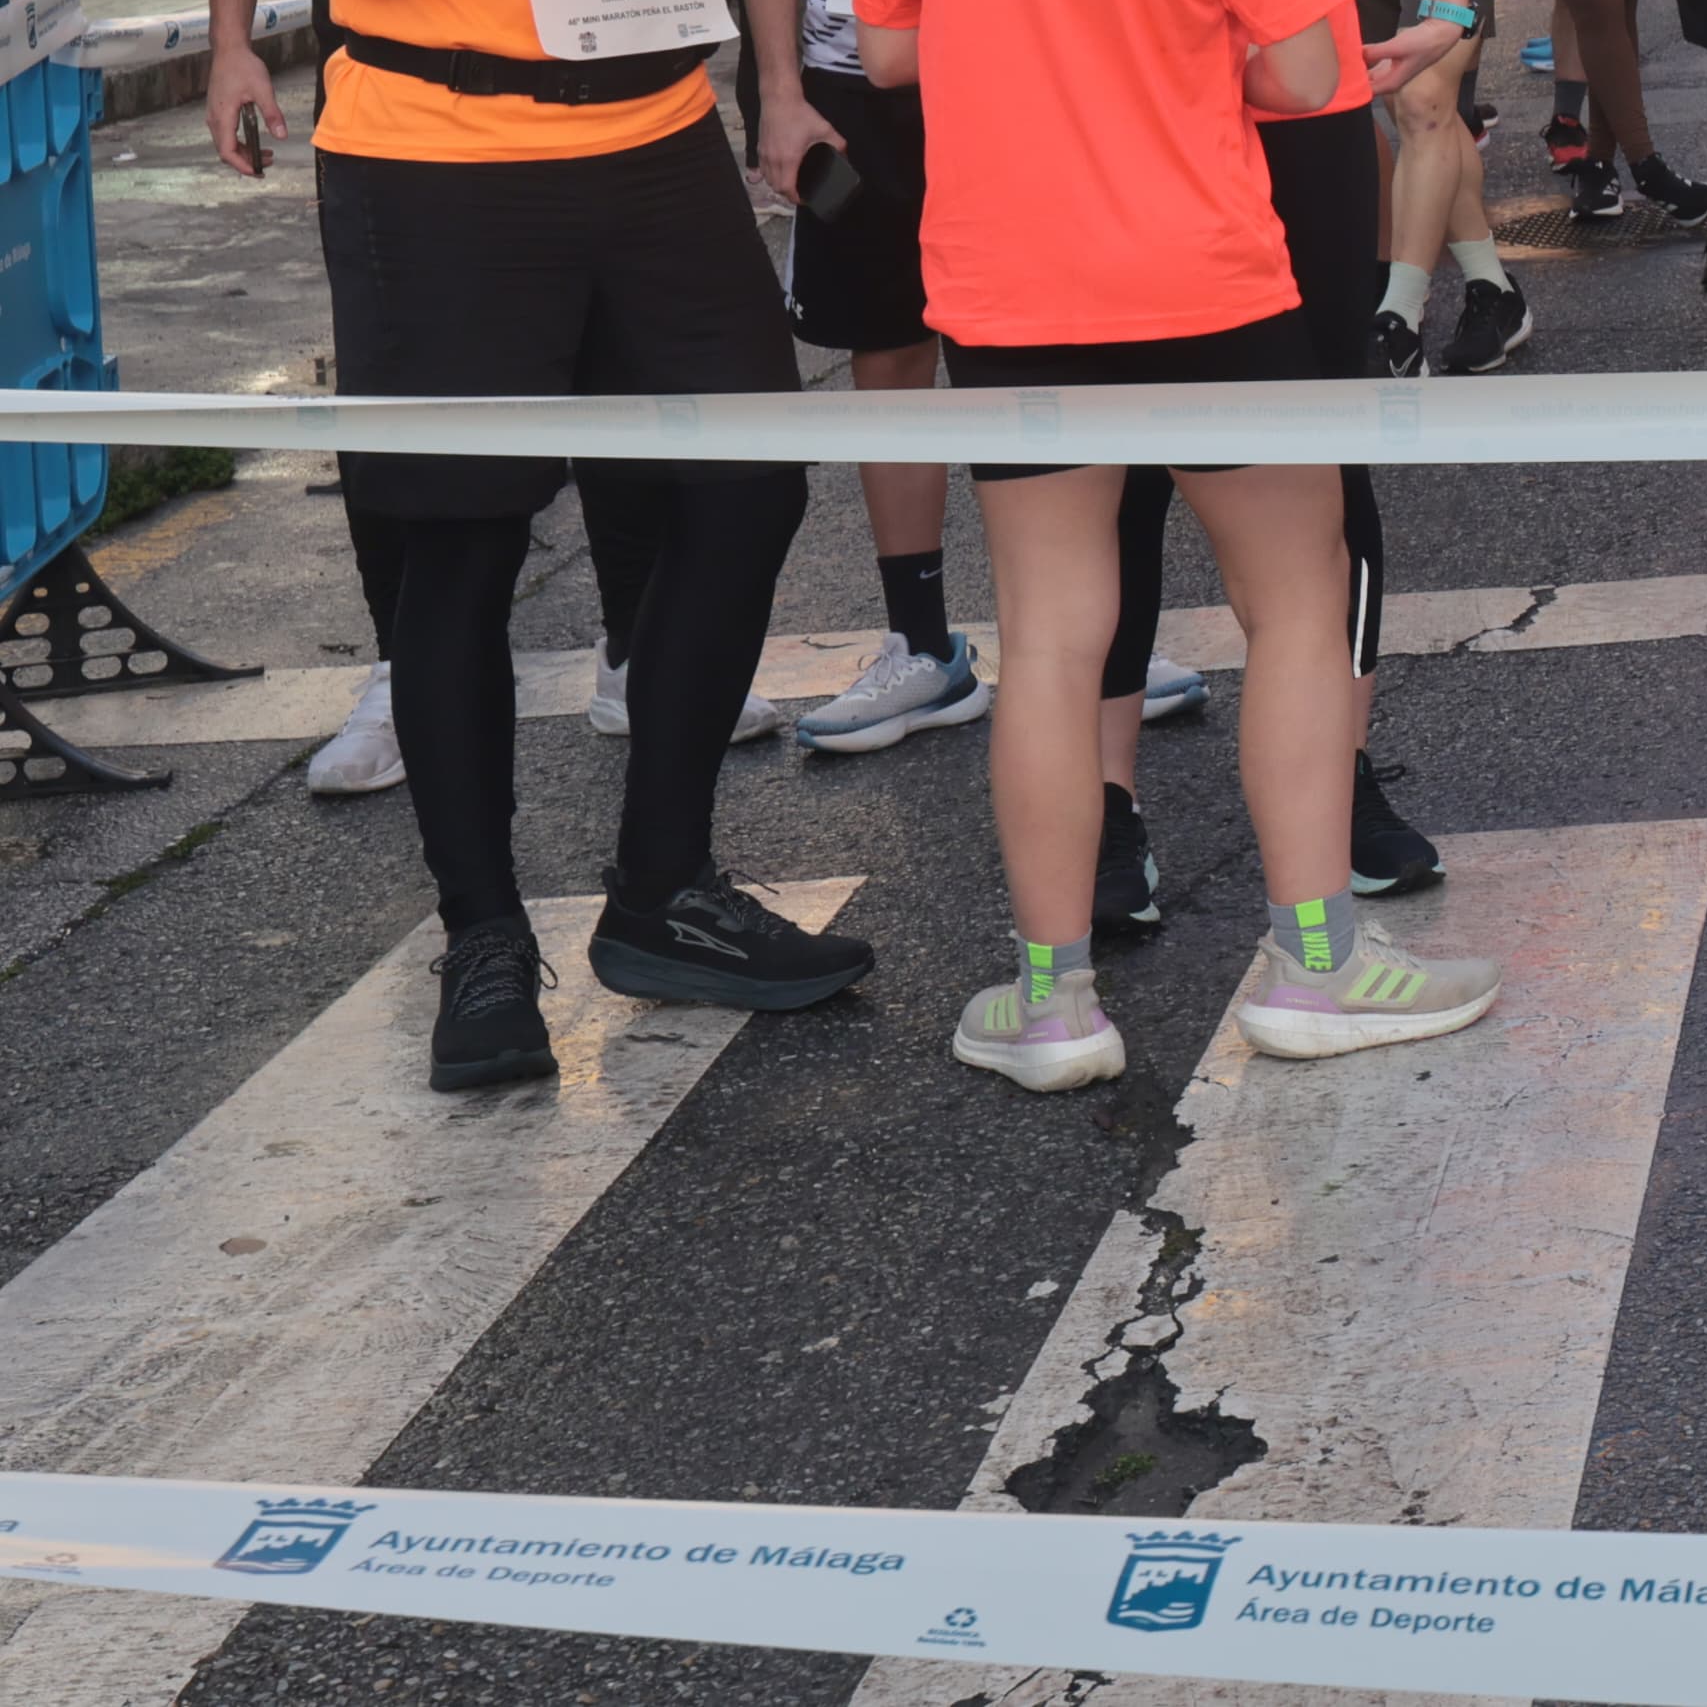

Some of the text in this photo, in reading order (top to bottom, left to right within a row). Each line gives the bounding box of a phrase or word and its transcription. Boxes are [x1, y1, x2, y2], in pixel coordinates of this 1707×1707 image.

[601, 9, 641, 23] MARATÓN
[642, 5, 661, 17] PEÑA
[662, 5, 672, 15] EL
[673, 1, 705, 13] BASTÓN
[370, 1529, 905, 1577] Ayuntamiento de Málaga
[348, 1555, 616, 1590] Área de Deporte
[1248, 1562, 1542, 1597] Ayuntamiento
[1554, 1574, 1607, 1600] de
[1237, 1598, 1495, 1636] Área de Deporte
